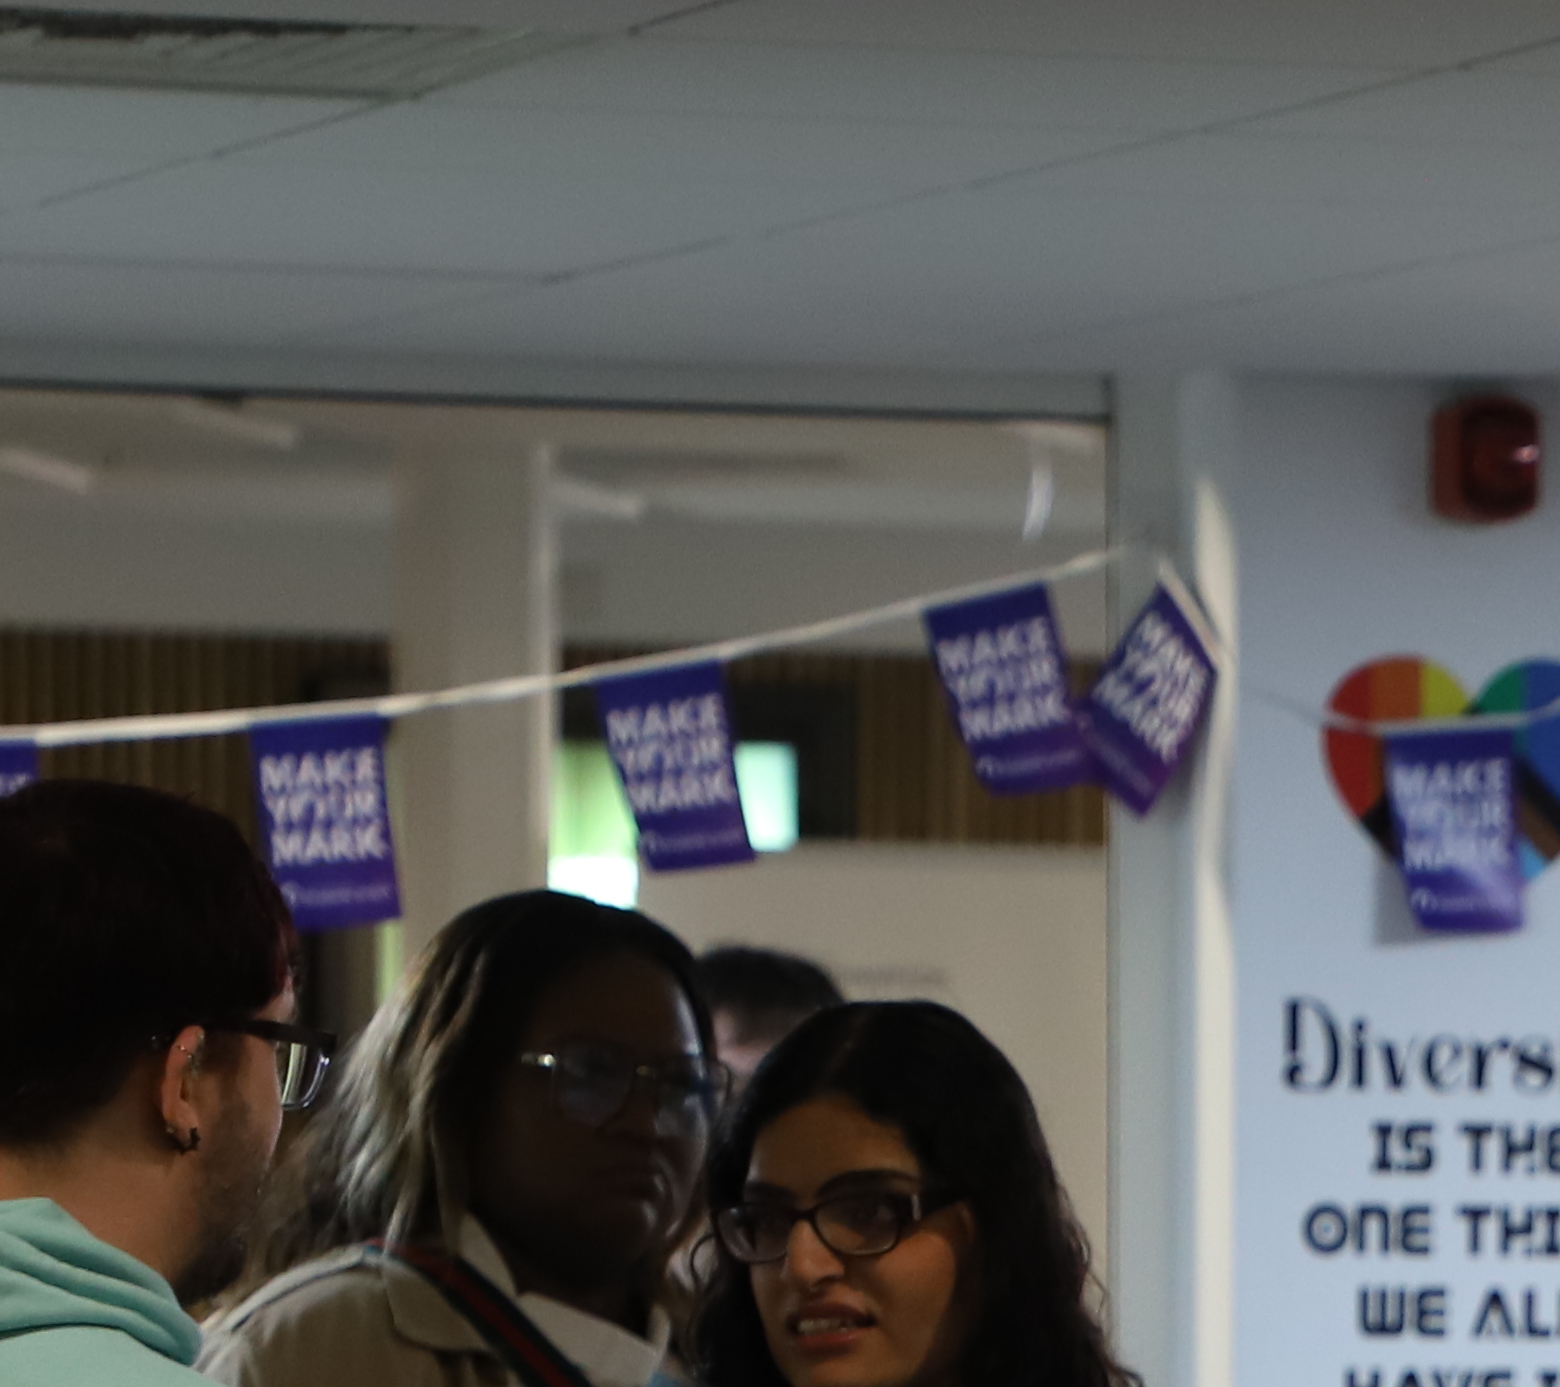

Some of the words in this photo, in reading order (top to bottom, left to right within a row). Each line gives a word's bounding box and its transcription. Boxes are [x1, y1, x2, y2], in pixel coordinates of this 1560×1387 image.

[937, 615, 1050, 672] MAKE
[606, 689, 724, 745] MAKE
[260, 747, 380, 793] MAKE
[626, 766, 740, 813] MARK
[1391, 756, 1507, 798] MAKE
[264, 785, 384, 826] YOUR
[270, 820, 389, 867] MARK
[1371, 1120, 1437, 1175] IS
[1303, 1203, 1432, 1257] ONE
[1357, 1286, 1447, 1338] WE
